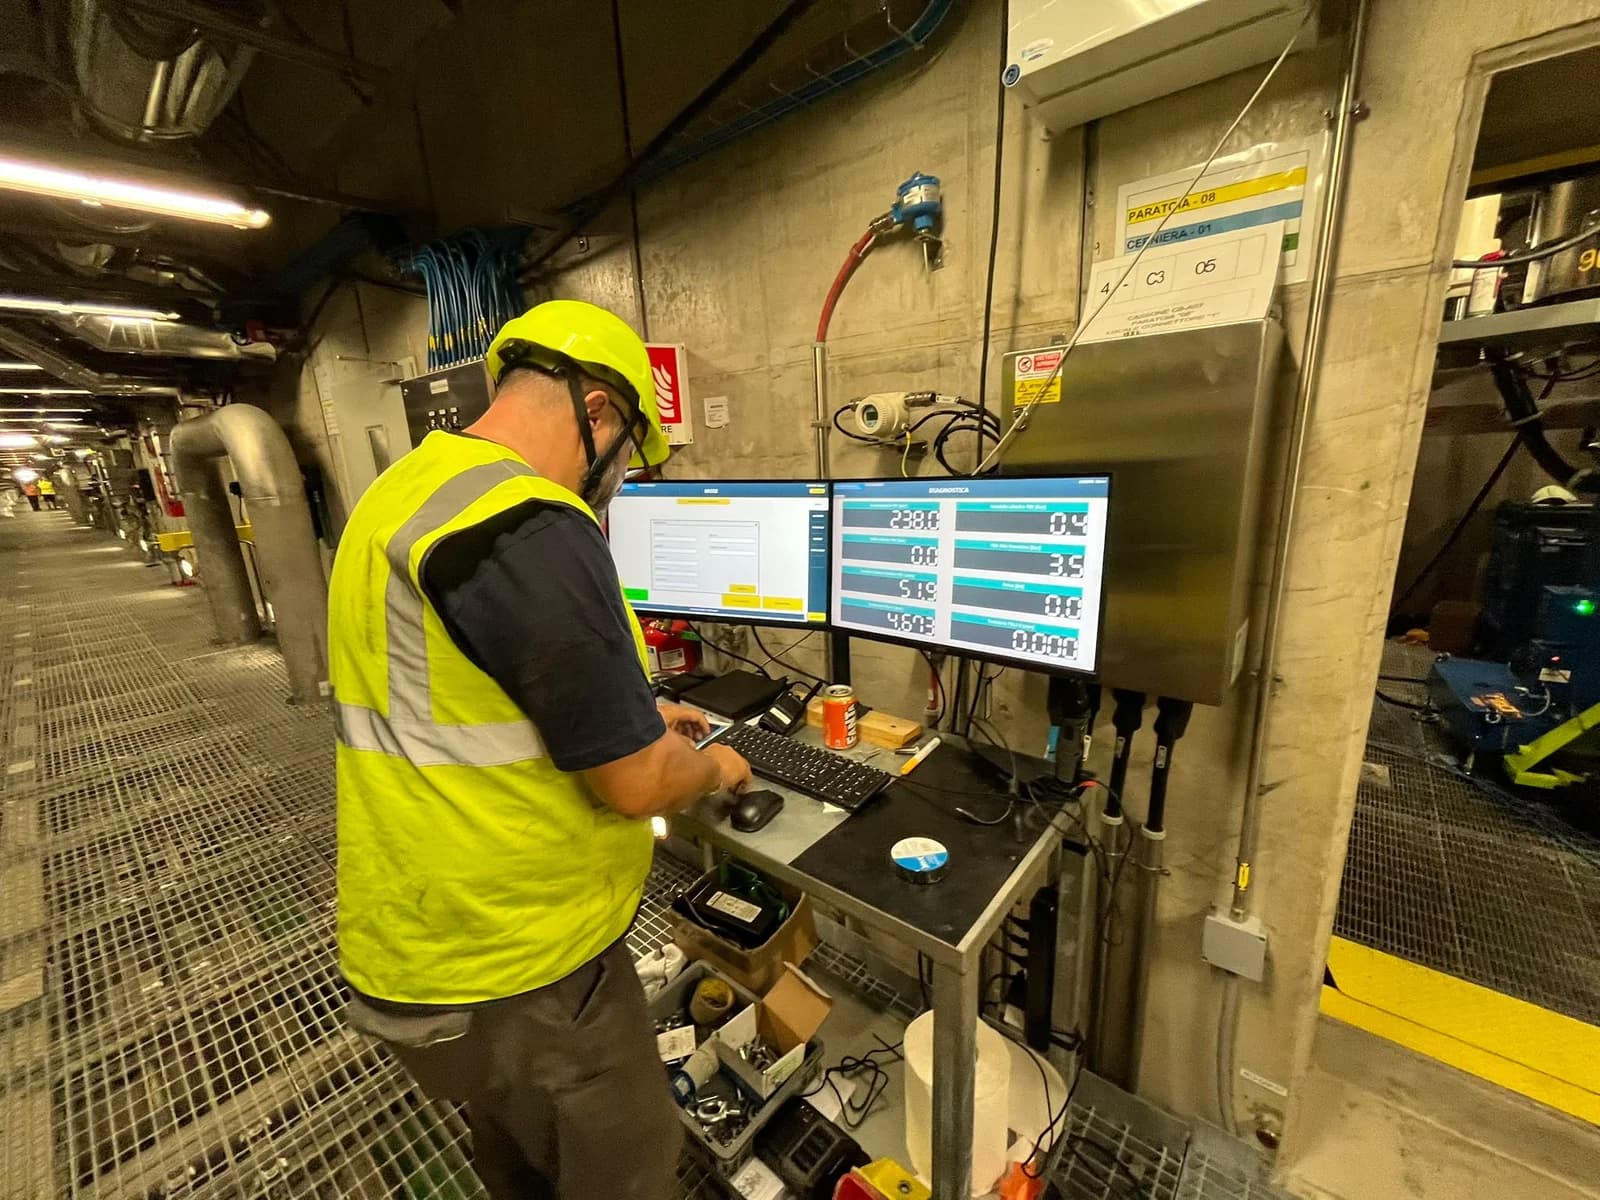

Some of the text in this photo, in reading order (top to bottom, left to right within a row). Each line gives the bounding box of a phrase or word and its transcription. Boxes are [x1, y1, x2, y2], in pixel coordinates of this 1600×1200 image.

[1200, 192, 1216, 204] 08
[1198, 224, 1212, 235] 01
[1100, 282, 1111, 295] 4
[1146, 270, 1165, 286] C3
[890, 509, 940, 530] 238.0
[1050, 512, 1088, 536] 0.4
[910, 545, 938, 566] 0.0
[1049, 553, 1085, 578] 3.5
[899, 579, 937, 601] 51.9
[1044, 594, 1081, 619] 0.0
[887, 612, 935, 637] 4.673
[1012, 630, 1078, 660] 0.000
